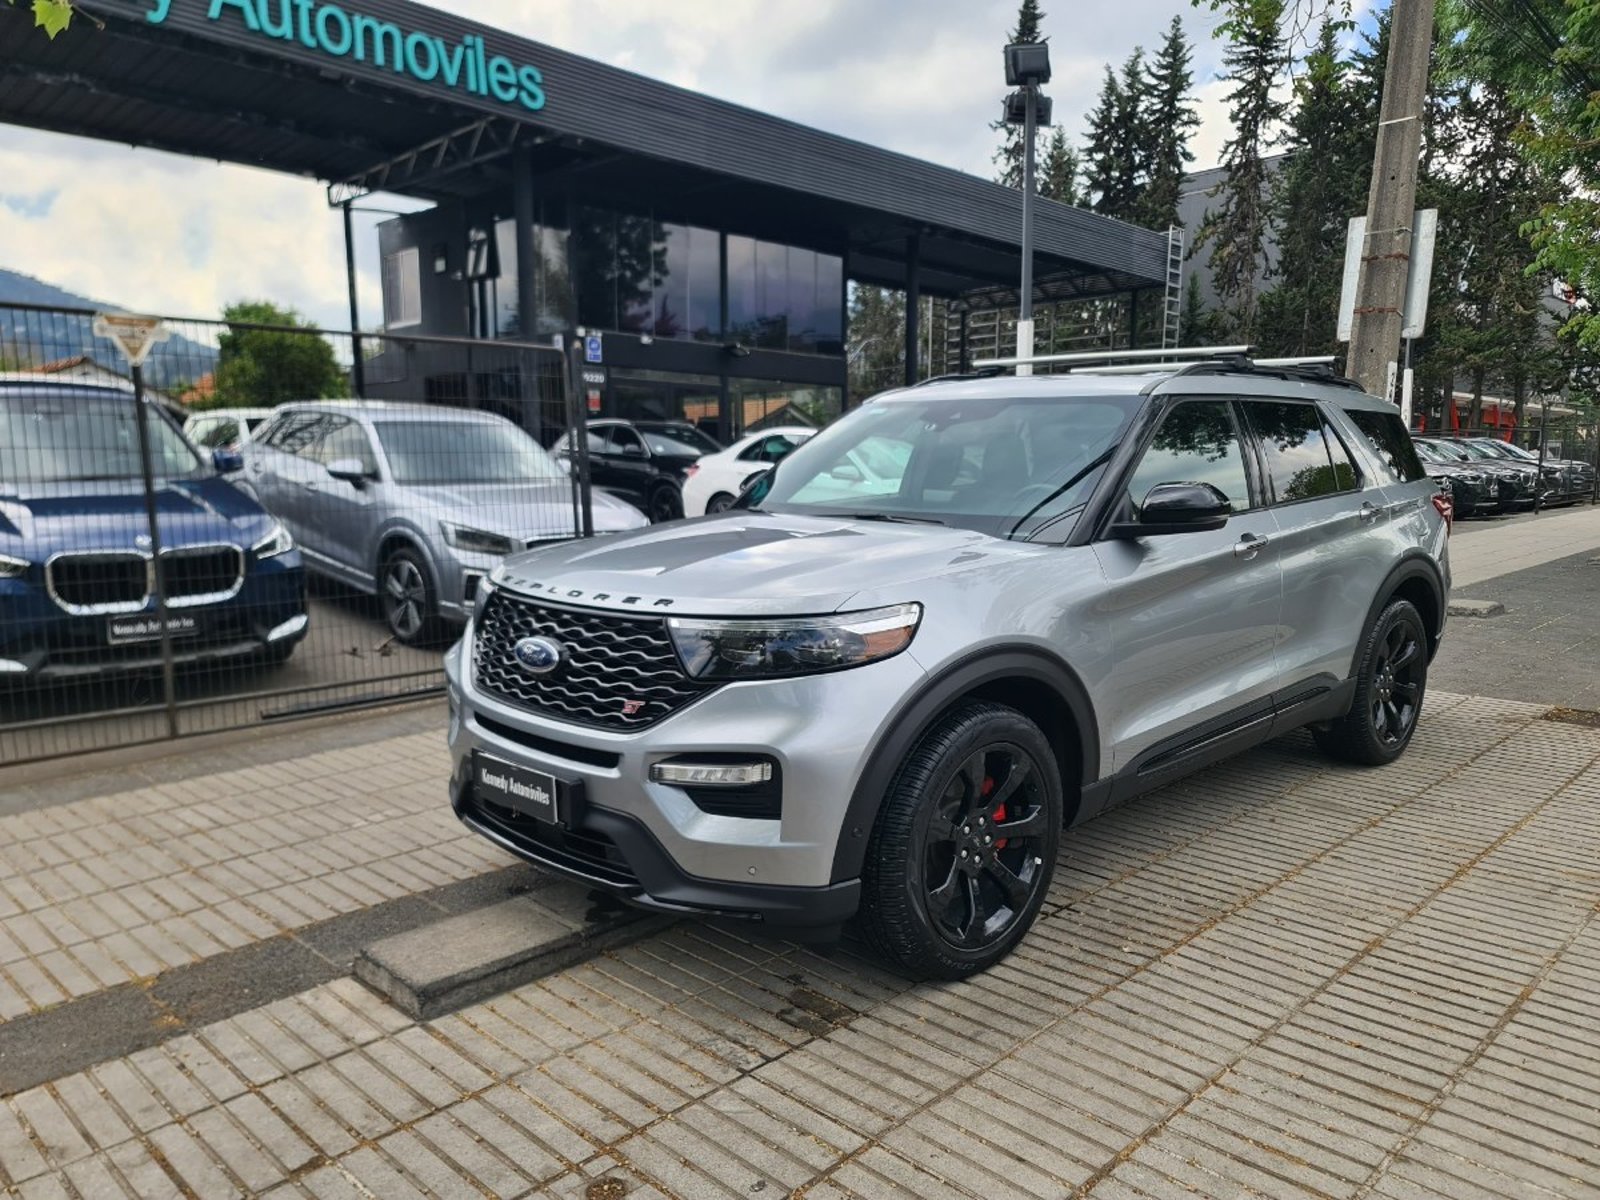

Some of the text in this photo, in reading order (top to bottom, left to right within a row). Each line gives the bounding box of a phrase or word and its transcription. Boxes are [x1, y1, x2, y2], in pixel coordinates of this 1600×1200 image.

[503, 575, 674, 607] EXPLORER
[621, 700, 646, 714] ST
[482, 768, 508, 794] Kennedy
